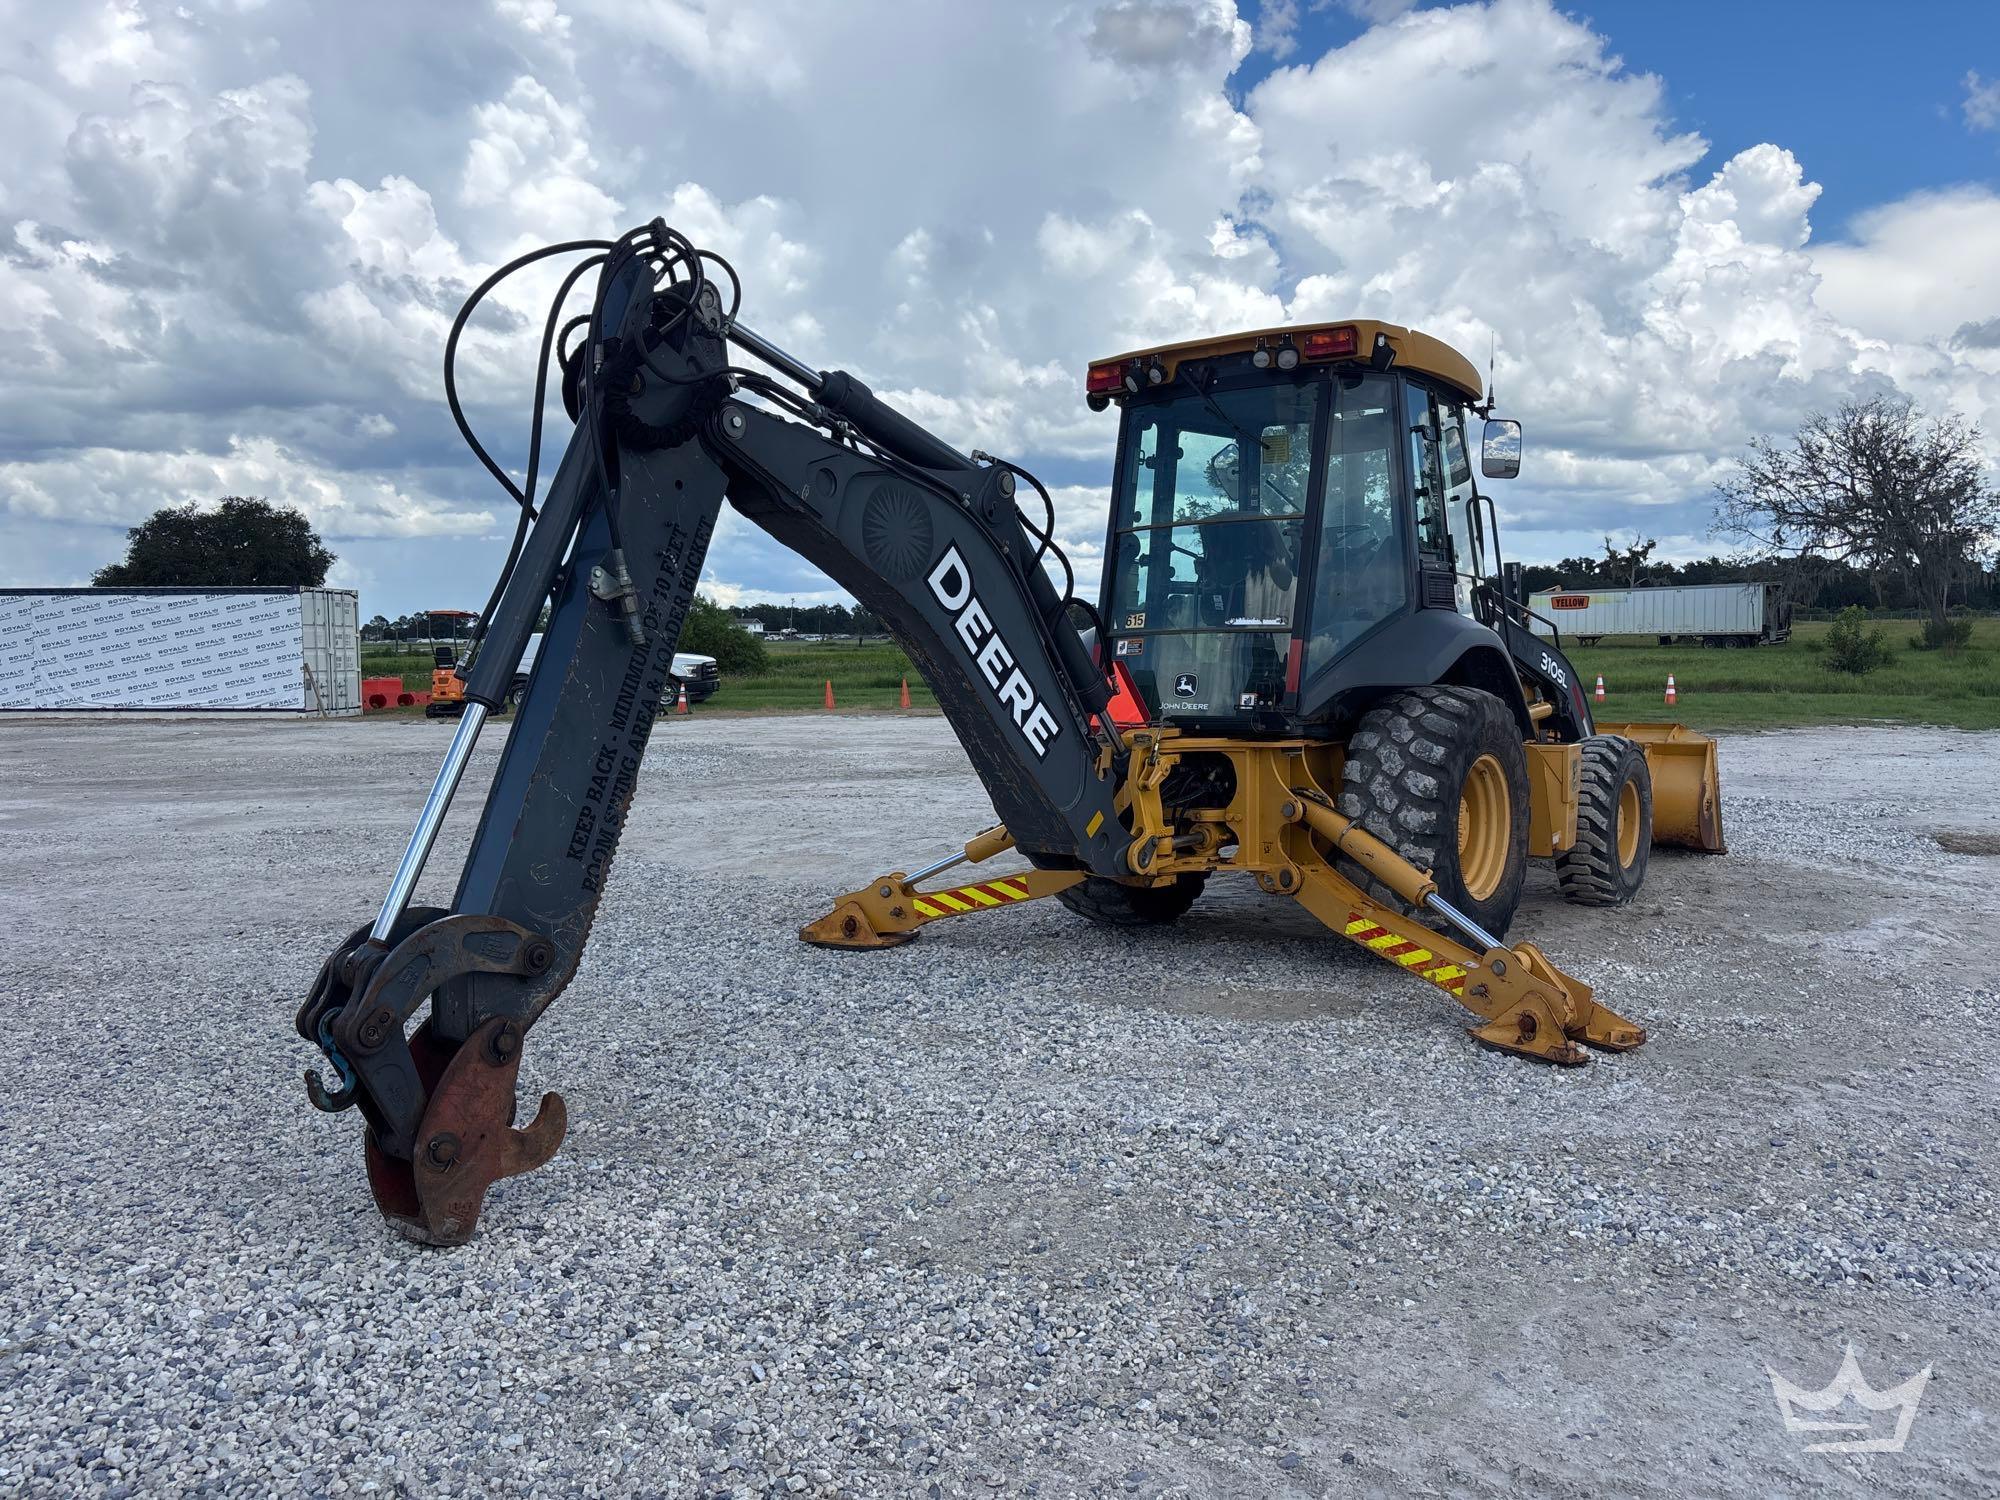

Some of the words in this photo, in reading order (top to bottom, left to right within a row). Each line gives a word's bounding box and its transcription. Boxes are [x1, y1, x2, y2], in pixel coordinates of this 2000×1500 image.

[679, 515, 714, 594] BUCKET
[108, 596, 130, 604] ROYAL
[168, 599, 190, 607] ROYAL
[1555, 597, 1585, 608] YELLOW
[72, 604, 94, 612] ROYAL
[227, 602, 248, 610] ROYAL
[131, 607, 153, 615] ROYAL
[189, 610, 211, 618] ROYAL
[35, 612, 57, 620] ROYAL
[94, 614, 116, 622] ROYAL
[250, 613, 272, 621] ROYAL
[152, 618, 174, 626] ROYAL
[212, 620, 234, 628] ROYAL
[1126, 615, 1144, 626] 615
[2, 624, 24, 632] ROYAL
[58, 622, 80, 630] ROYAL
[115, 625, 137, 633] ROYAL
[271, 623, 292, 632] ROYAL
[175, 628, 197, 636] ROYAL
[233, 631, 255, 639] ROYAL
[652, 595, 690, 677] LOADER
[78, 633, 100, 641] ROYAL
[138, 636, 160, 644] ROYAL
[42, 640, 64, 648] ROYAL
[101, 643, 123, 651] ROYAL
[196, 639, 218, 647] ROYAL
[256, 641, 278, 650] ROYAL
[159, 646, 180, 654] ROYAL
[219, 649, 241, 657] ROYAL
[927, 546, 1059, 758] DEERE
[9, 653, 31, 661] ROYAL
[64, 651, 86, 659] ROYAL
[122, 654, 144, 662] ROYAL
[277, 652, 299, 660] ROYAL
[182, 657, 204, 665] ROYAL
[240, 660, 262, 668] ROYAL
[85, 661, 107, 670] ROYAL
[145, 664, 166, 672] ROYAL
[48, 669, 70, 677] ROYAL
[202, 668, 224, 676] ROYAL
[263, 670, 285, 678] ROYAL
[1540, 652, 1568, 689] 310SL
[108, 672, 130, 680] ROYAL
[165, 675, 187, 683] ROYAL
[71, 679, 93, 687] ROYAL
[226, 678, 248, 686] ROYAL
[35, 687, 57, 695] ROYAL
[128, 683, 150, 691] ROYAL
[188, 686, 210, 694] ROYAL
[646, 680, 664, 694] &
[91, 690, 113, 698] ROYAL
[246, 689, 268, 697] ROYAL
[566, 806, 596, 862] KEEP
[586, 744, 618, 804] BACK
[611, 636, 654, 732] MINIMUM
[643, 601, 662, 630] OF
[660, 522, 687, 577] FEET
[55, 697, 77, 705] ROYAL
[151, 693, 173, 701] ROYAL
[209, 696, 231, 704] ROYAL
[2, 699, 24, 707] ROYAL
[269, 699, 291, 707] ROYAL
[628, 699, 657, 752] AREA
[604, 756, 637, 826] SWING
[582, 828, 615, 893] BOOM
